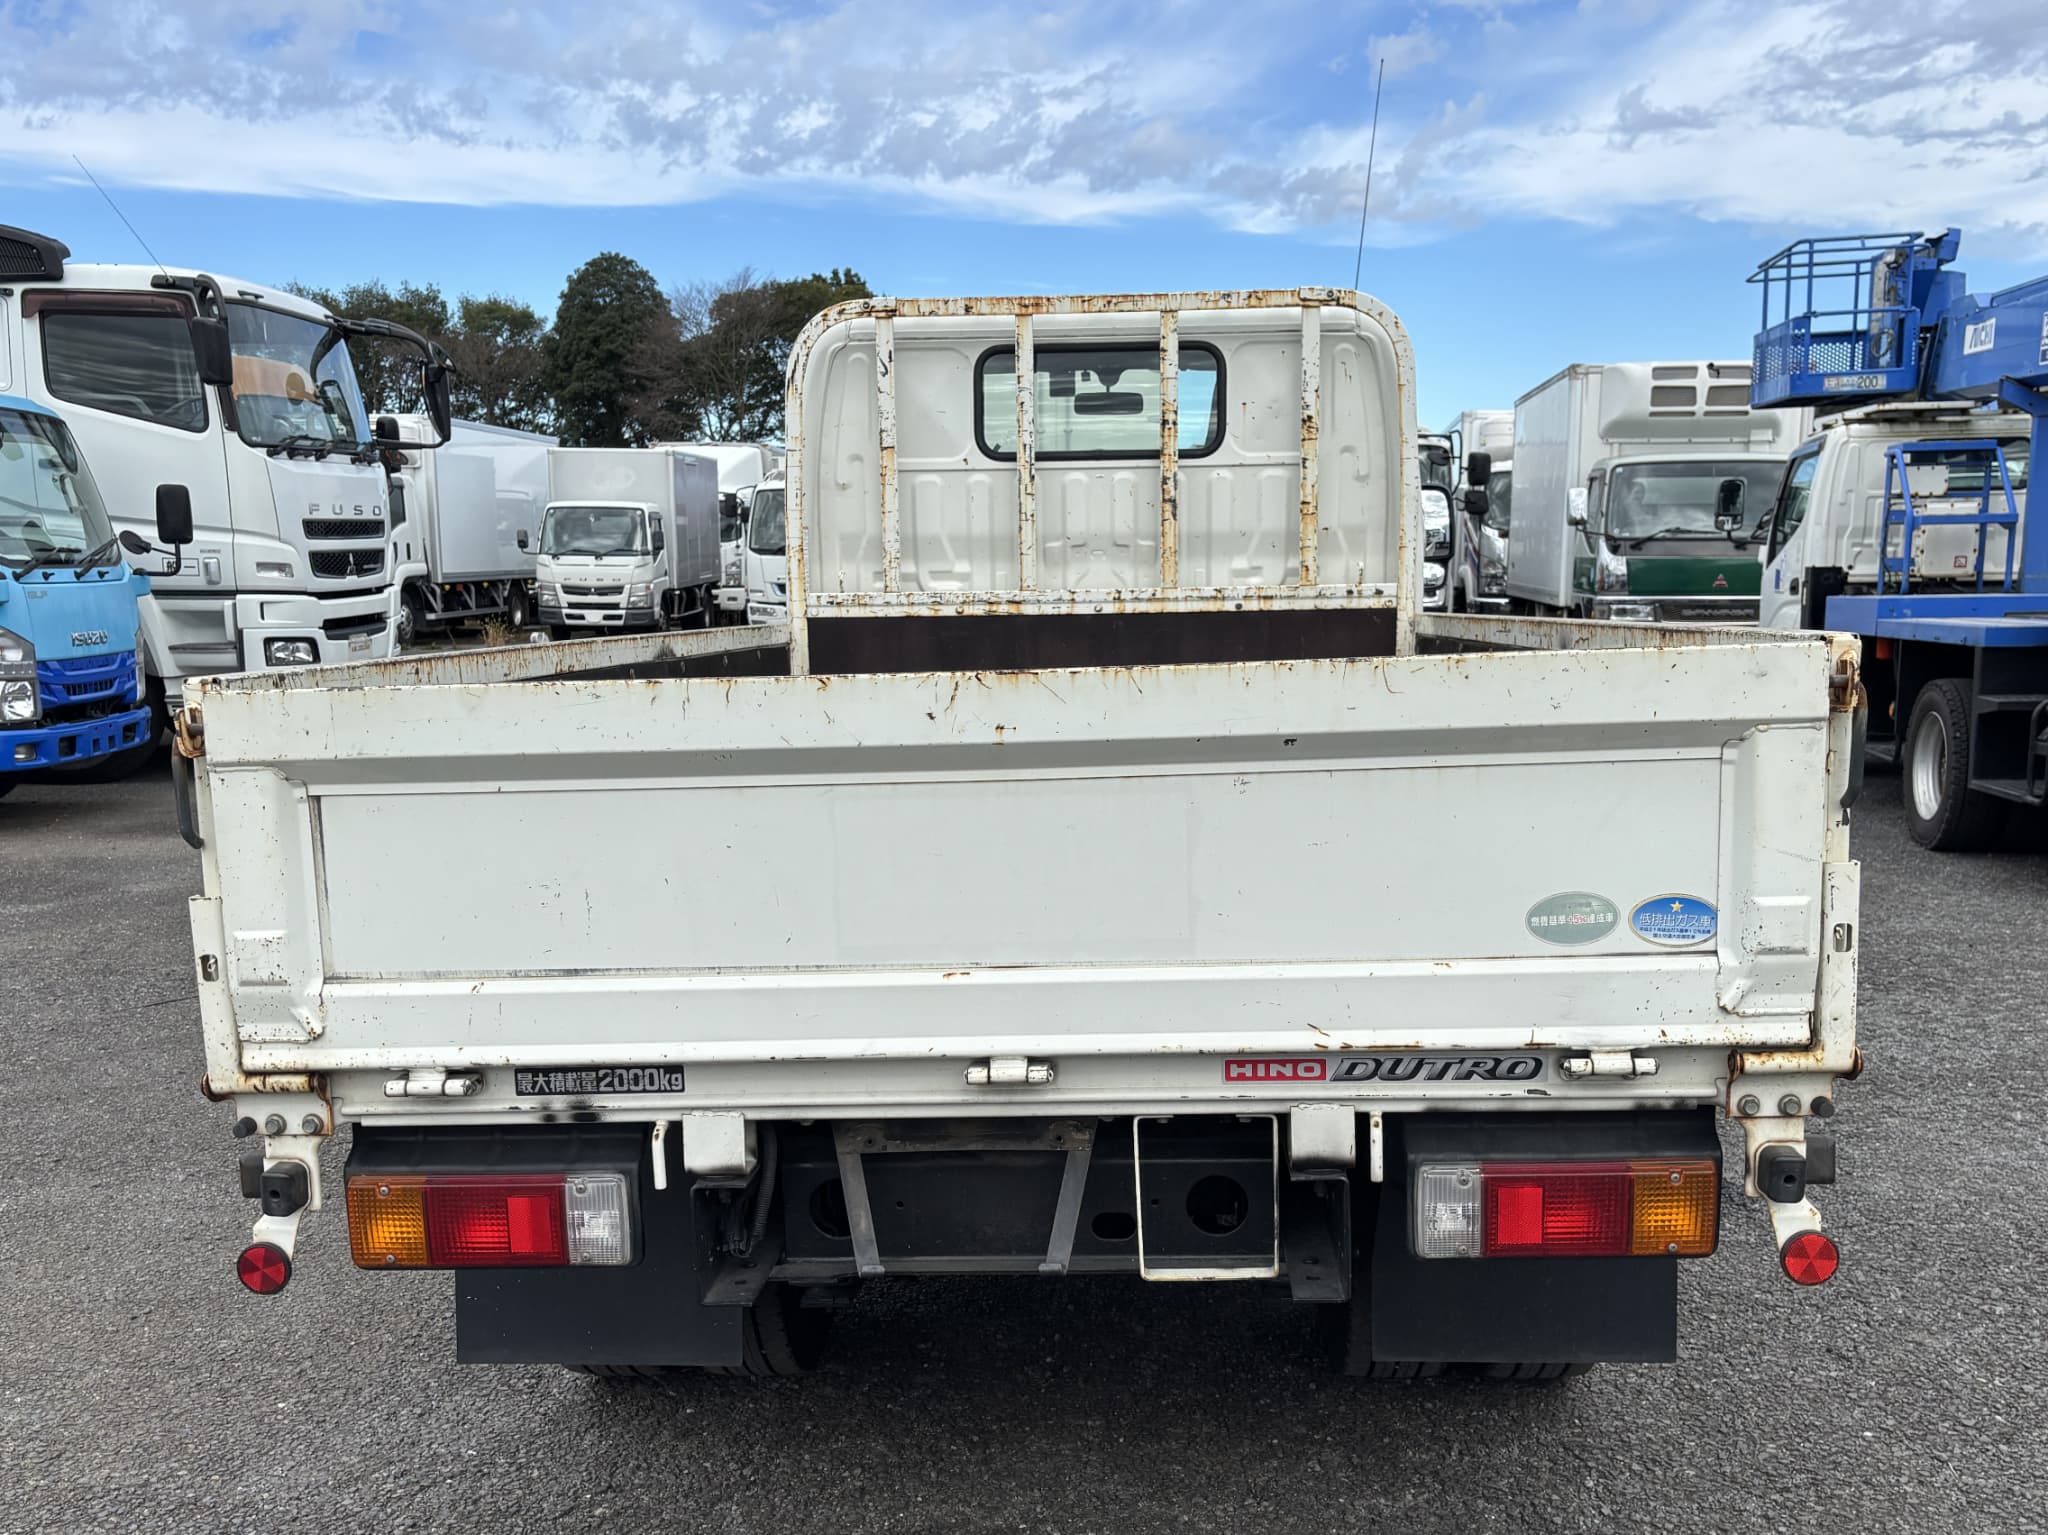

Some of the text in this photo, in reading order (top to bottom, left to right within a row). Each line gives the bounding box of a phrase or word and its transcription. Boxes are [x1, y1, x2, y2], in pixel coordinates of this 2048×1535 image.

[1857, 375, 1879, 389] 200
[308, 503, 382, 516] FUSO
[71, 630, 108, 648] ISUZU
[1640, 912, 1712, 928] 低排出ガス車
[1229, 1056, 1544, 1082] HINO DUTRO
